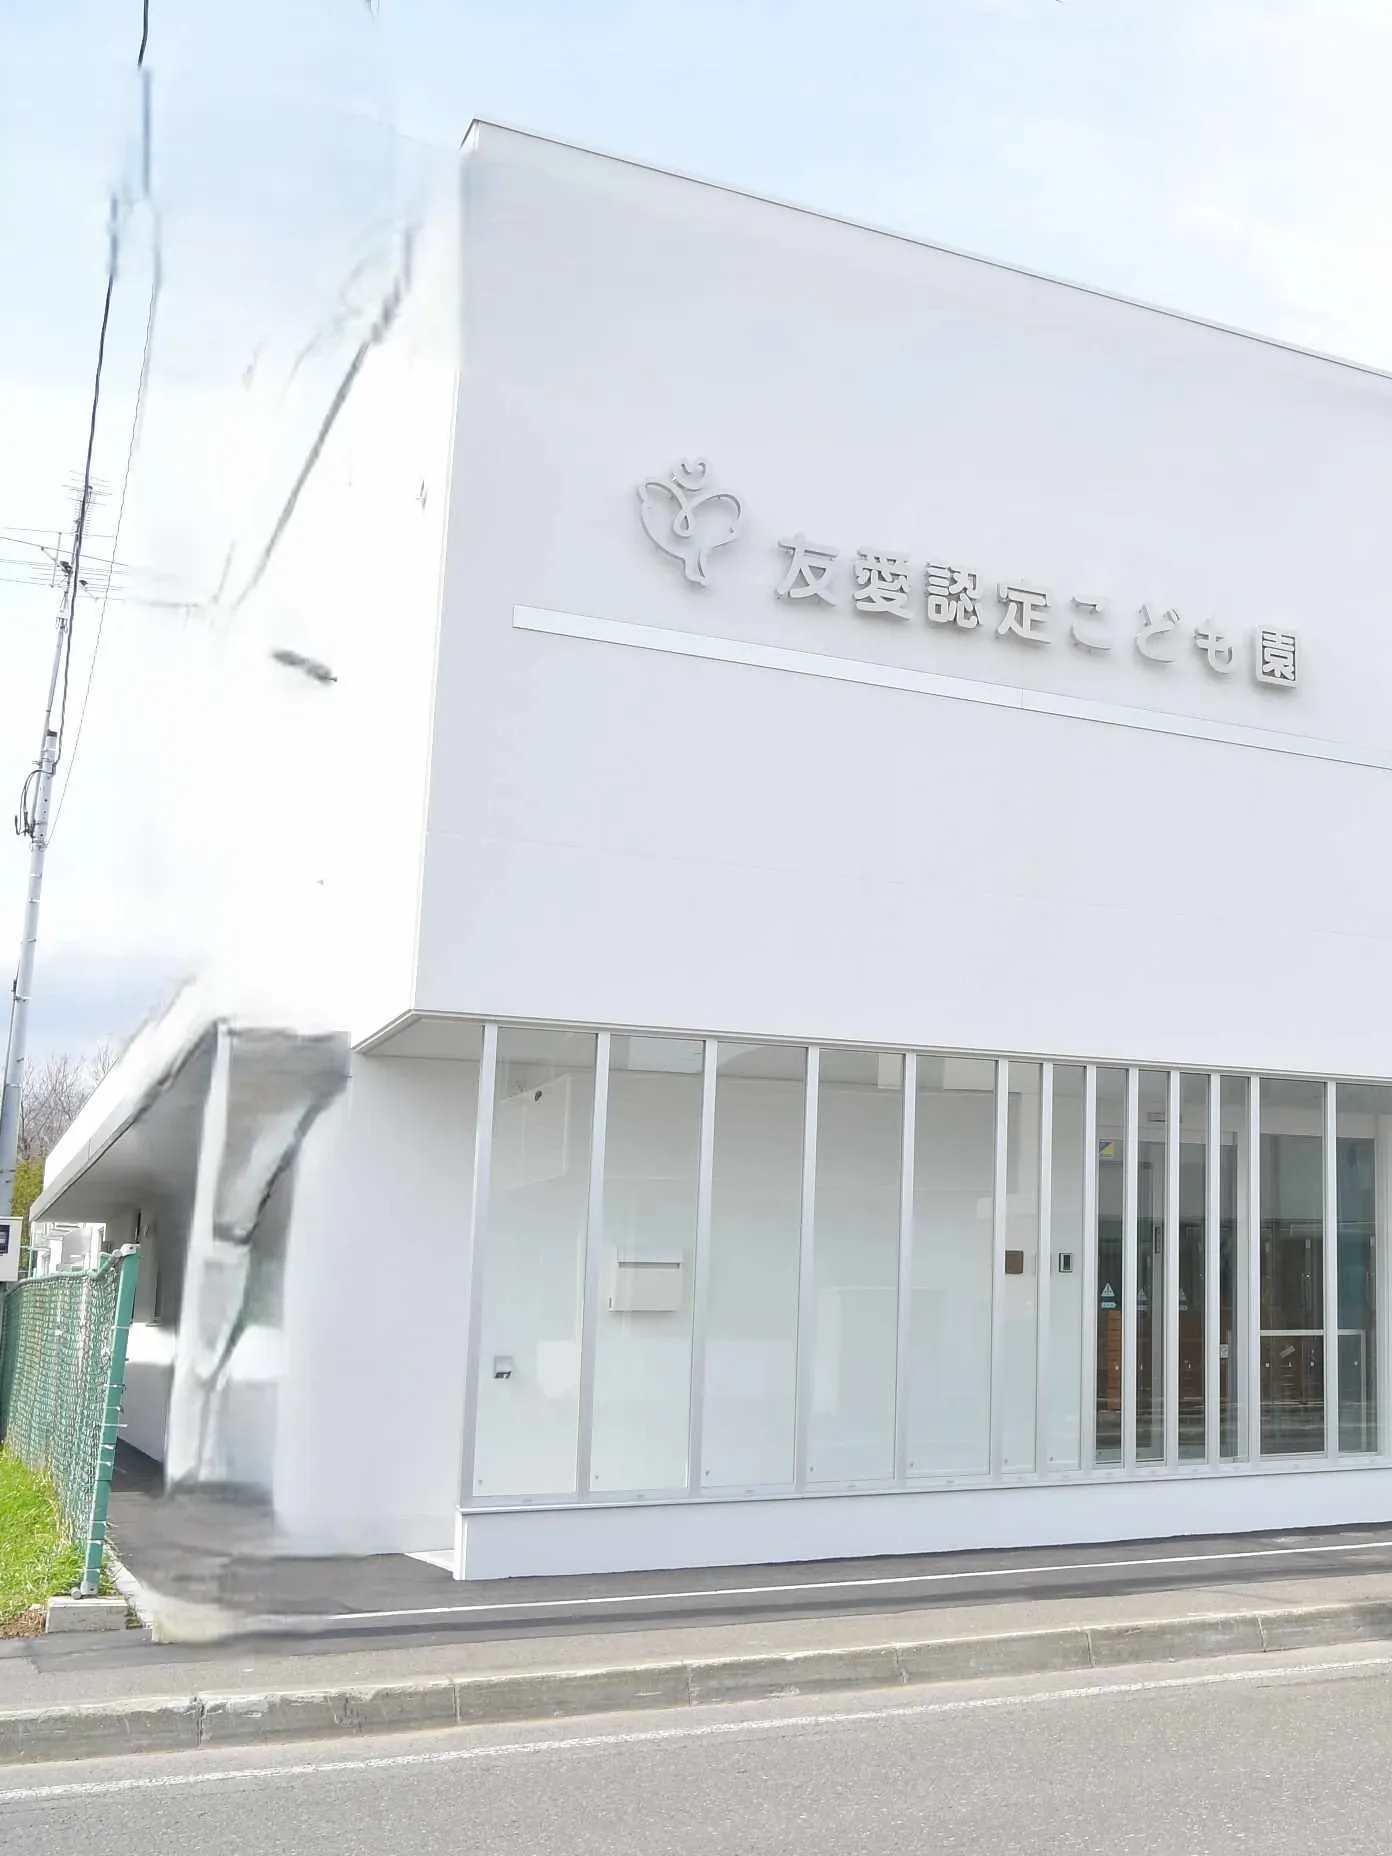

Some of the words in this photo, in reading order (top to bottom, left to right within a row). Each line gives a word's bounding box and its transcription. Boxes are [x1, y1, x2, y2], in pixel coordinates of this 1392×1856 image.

[776, 533, 1297, 687] 友愛認定こども園
